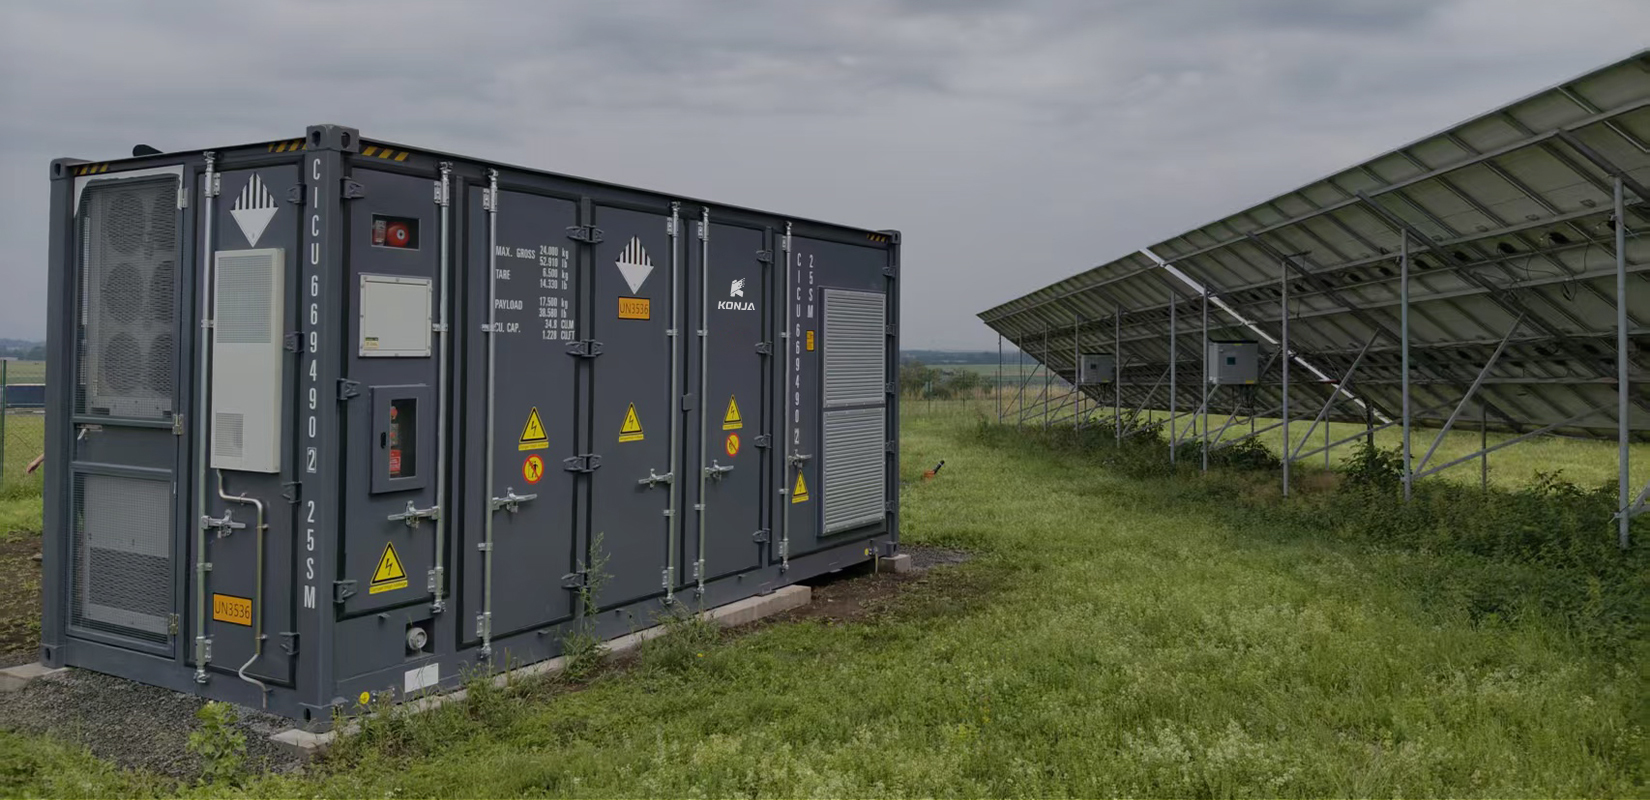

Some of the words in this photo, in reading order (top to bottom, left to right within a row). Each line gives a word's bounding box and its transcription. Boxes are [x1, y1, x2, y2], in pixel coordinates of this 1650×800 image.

[495, 246, 512, 257] MAX.
[516, 248, 535, 259] GROSS
[540, 245, 558, 256] 24.000
[562, 247, 569, 260] kg
[562, 259, 567, 268] lb
[495, 269, 510, 280] TARE
[543, 268, 558, 278] 6.500
[562, 270, 568, 281] kg
[540, 279, 557, 289] 14.330
[562, 281, 567, 290] lb
[494, 299, 523, 310] PAYLOAD
[539, 296, 557, 306] 17.500
[561, 298, 568, 310] kg
[619, 303, 649, 315] UN3536
[717, 301, 756, 311] KONJA
[561, 309, 566, 318] lb
[506, 322, 521, 333] CAP.
[544, 319, 557, 329] 34.8
[303, 500, 316, 609] 25SM
[214, 600, 251, 619] UN3536
